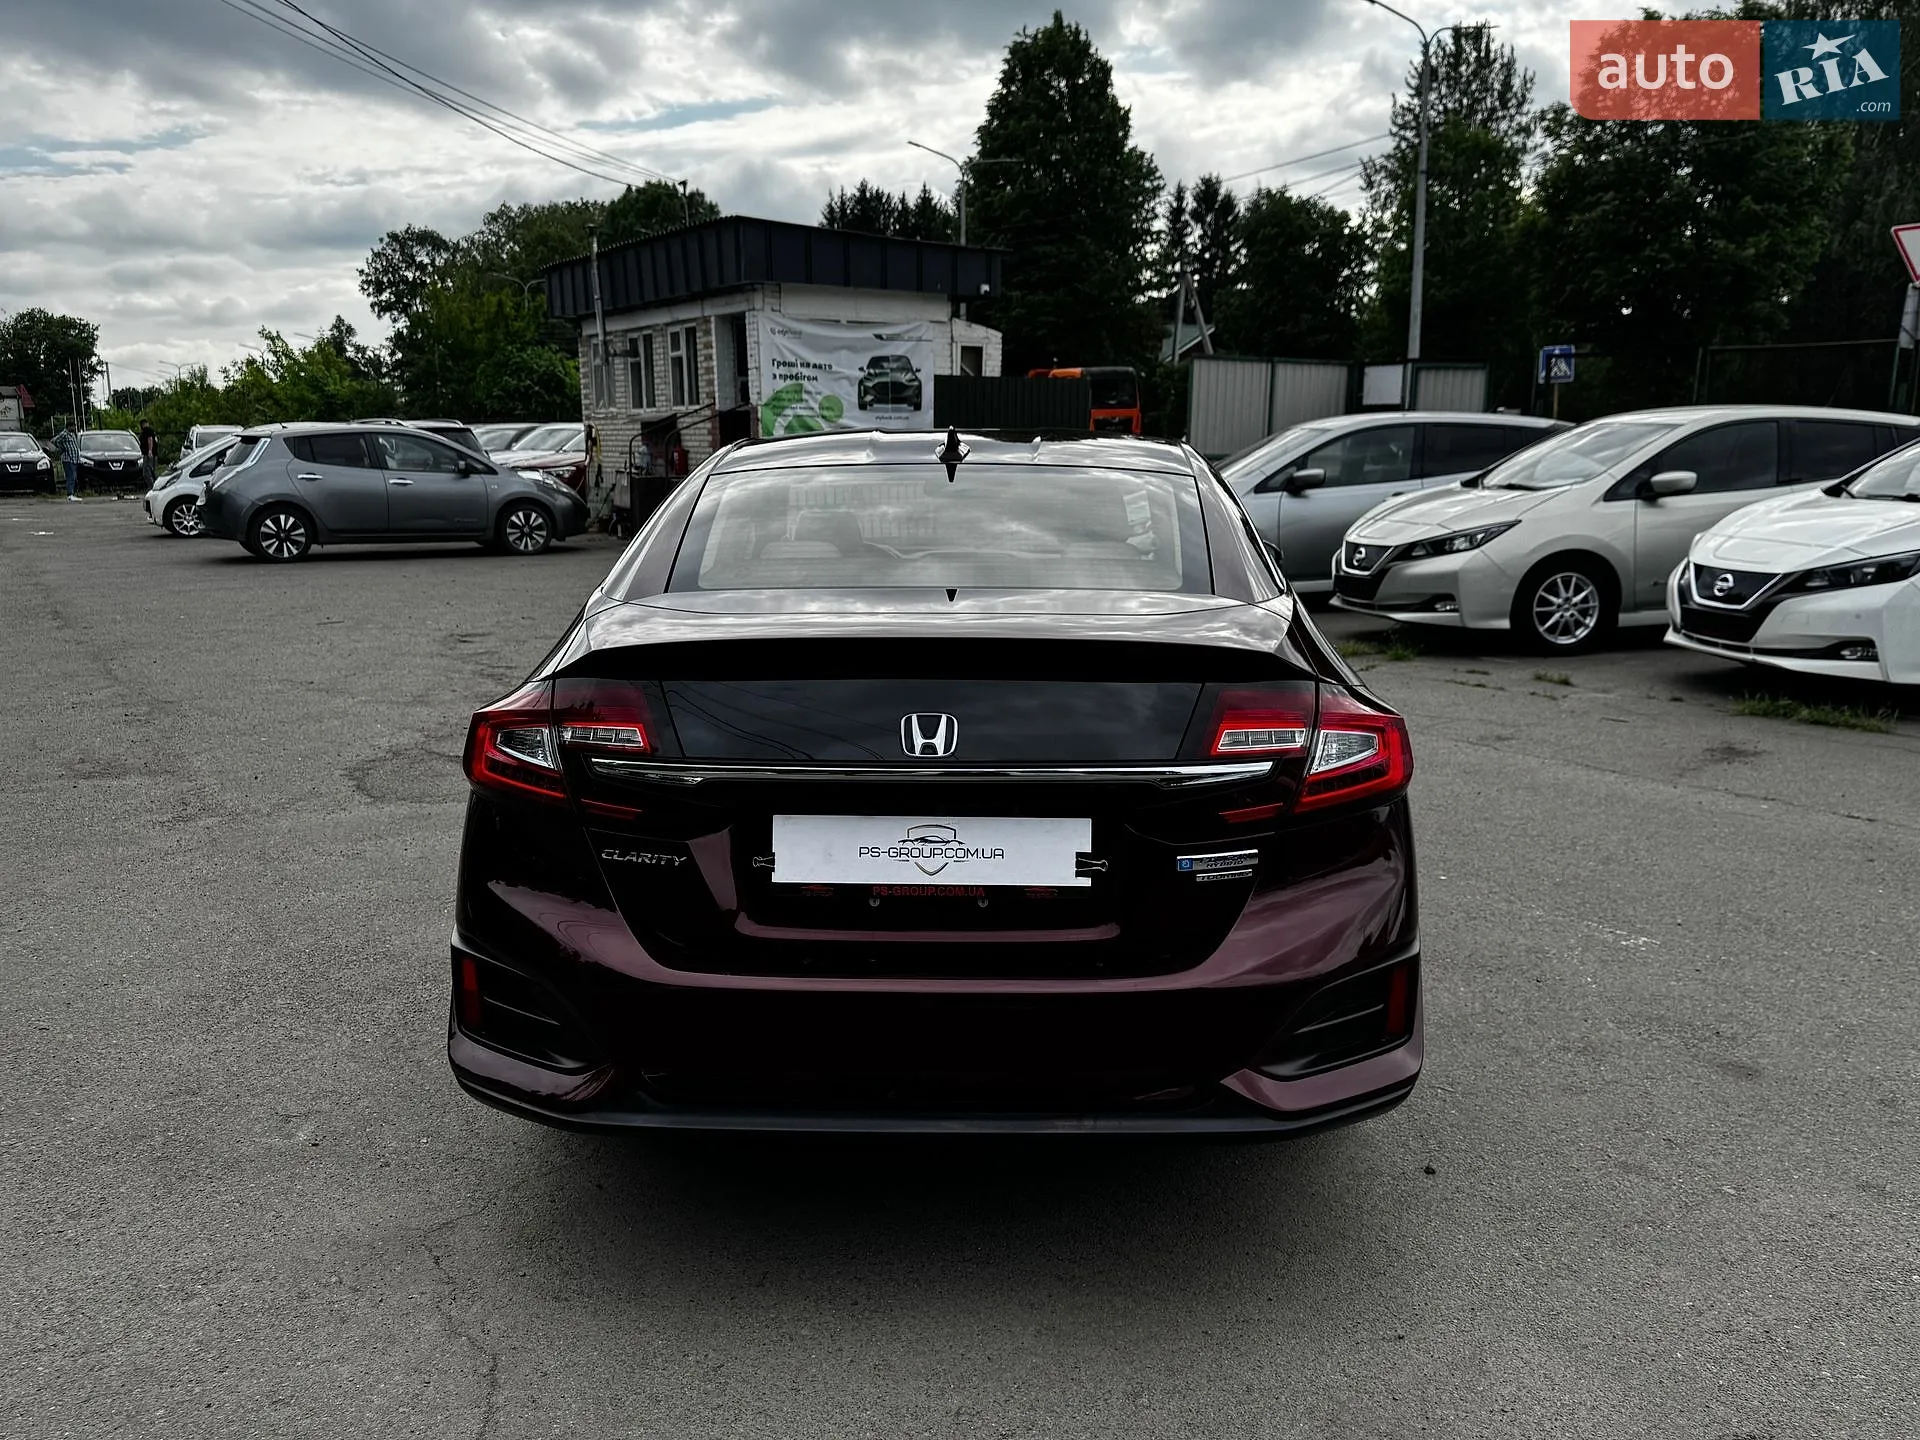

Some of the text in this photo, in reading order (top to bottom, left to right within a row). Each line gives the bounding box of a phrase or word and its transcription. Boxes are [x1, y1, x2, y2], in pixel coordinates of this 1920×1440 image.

[771, 358, 798, 370] Гроші
[812, 362, 833, 371] авто
[779, 372, 818, 383] пробігом
[601, 849, 688, 867] CLARITY
[858, 846, 1005, 860] PS-GROUP.COM.UA
[872, 886, 985, 898] PS-GROUP.COM.UA
